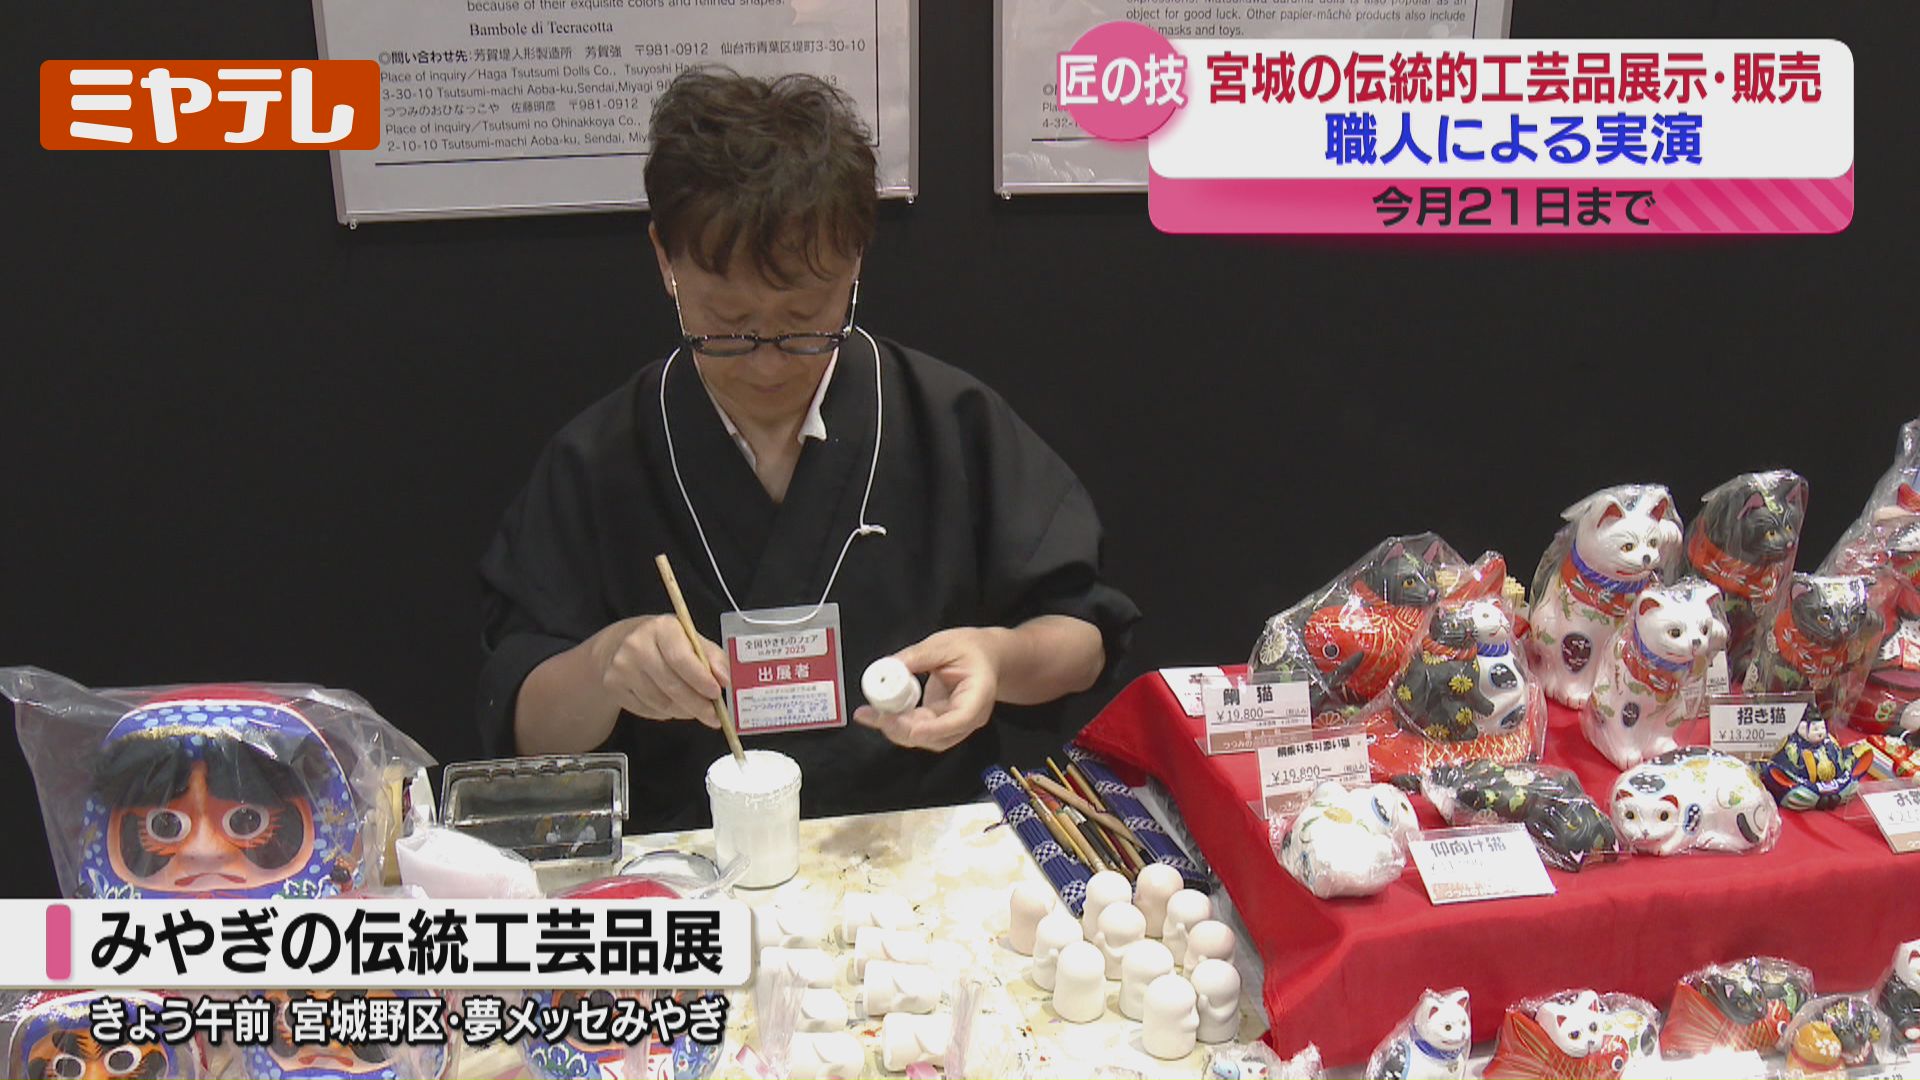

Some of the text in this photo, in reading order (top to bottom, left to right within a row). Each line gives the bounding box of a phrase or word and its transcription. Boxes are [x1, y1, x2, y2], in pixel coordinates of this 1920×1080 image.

[467, 0, 520, 12] because
[523, 0, 536, 11] of
[540, 0, 566, 10] their
[571, 0, 624, 11] exquisite
[1126, 8, 1159, 21] object
[1164, 8, 1179, 19] for
[1184, 8, 1212, 21] good
[1216, 8, 1241, 19] luck.
[1246, 8, 1276, 20] Other
[1356, 9, 1401, 21] products
[1404, 10, 1426, 21] also
[1429, 10, 1466, 21] include
[469, 23, 528, 37] Bambole
[531, 21, 544, 35] di
[1158, 25, 1192, 36] masks
[1195, 25, 1215, 36] and
[1219, 25, 1244, 37] toys.
[380, 71, 411, 83] Place
[415, 70, 428, 82] of
[512, 66, 560, 80] Tsutsumi
[563, 65, 591, 78] Dolls
[625, 63, 672, 77] Tsuyoshi
[382, 88, 433, 101] 3-30-10
[437, 84, 523, 99] Tsutsumi-machi
[385, 122, 417, 135] Place
[420, 122, 432, 134] of
[534, 119, 548, 130] no
[551, 116, 615, 131] Ohinakkoya
[387, 139, 438, 152] 2-10-10
[442, 135, 528, 150] Tsutsumi-machi
[584, 132, 626, 146] Sendai,
[745, 634, 819, 650] 全国やきものフェア
[785, 645, 806, 655] 2025
[758, 663, 810, 682] 出展者
[1737, 706, 1786, 726] 招き猫
